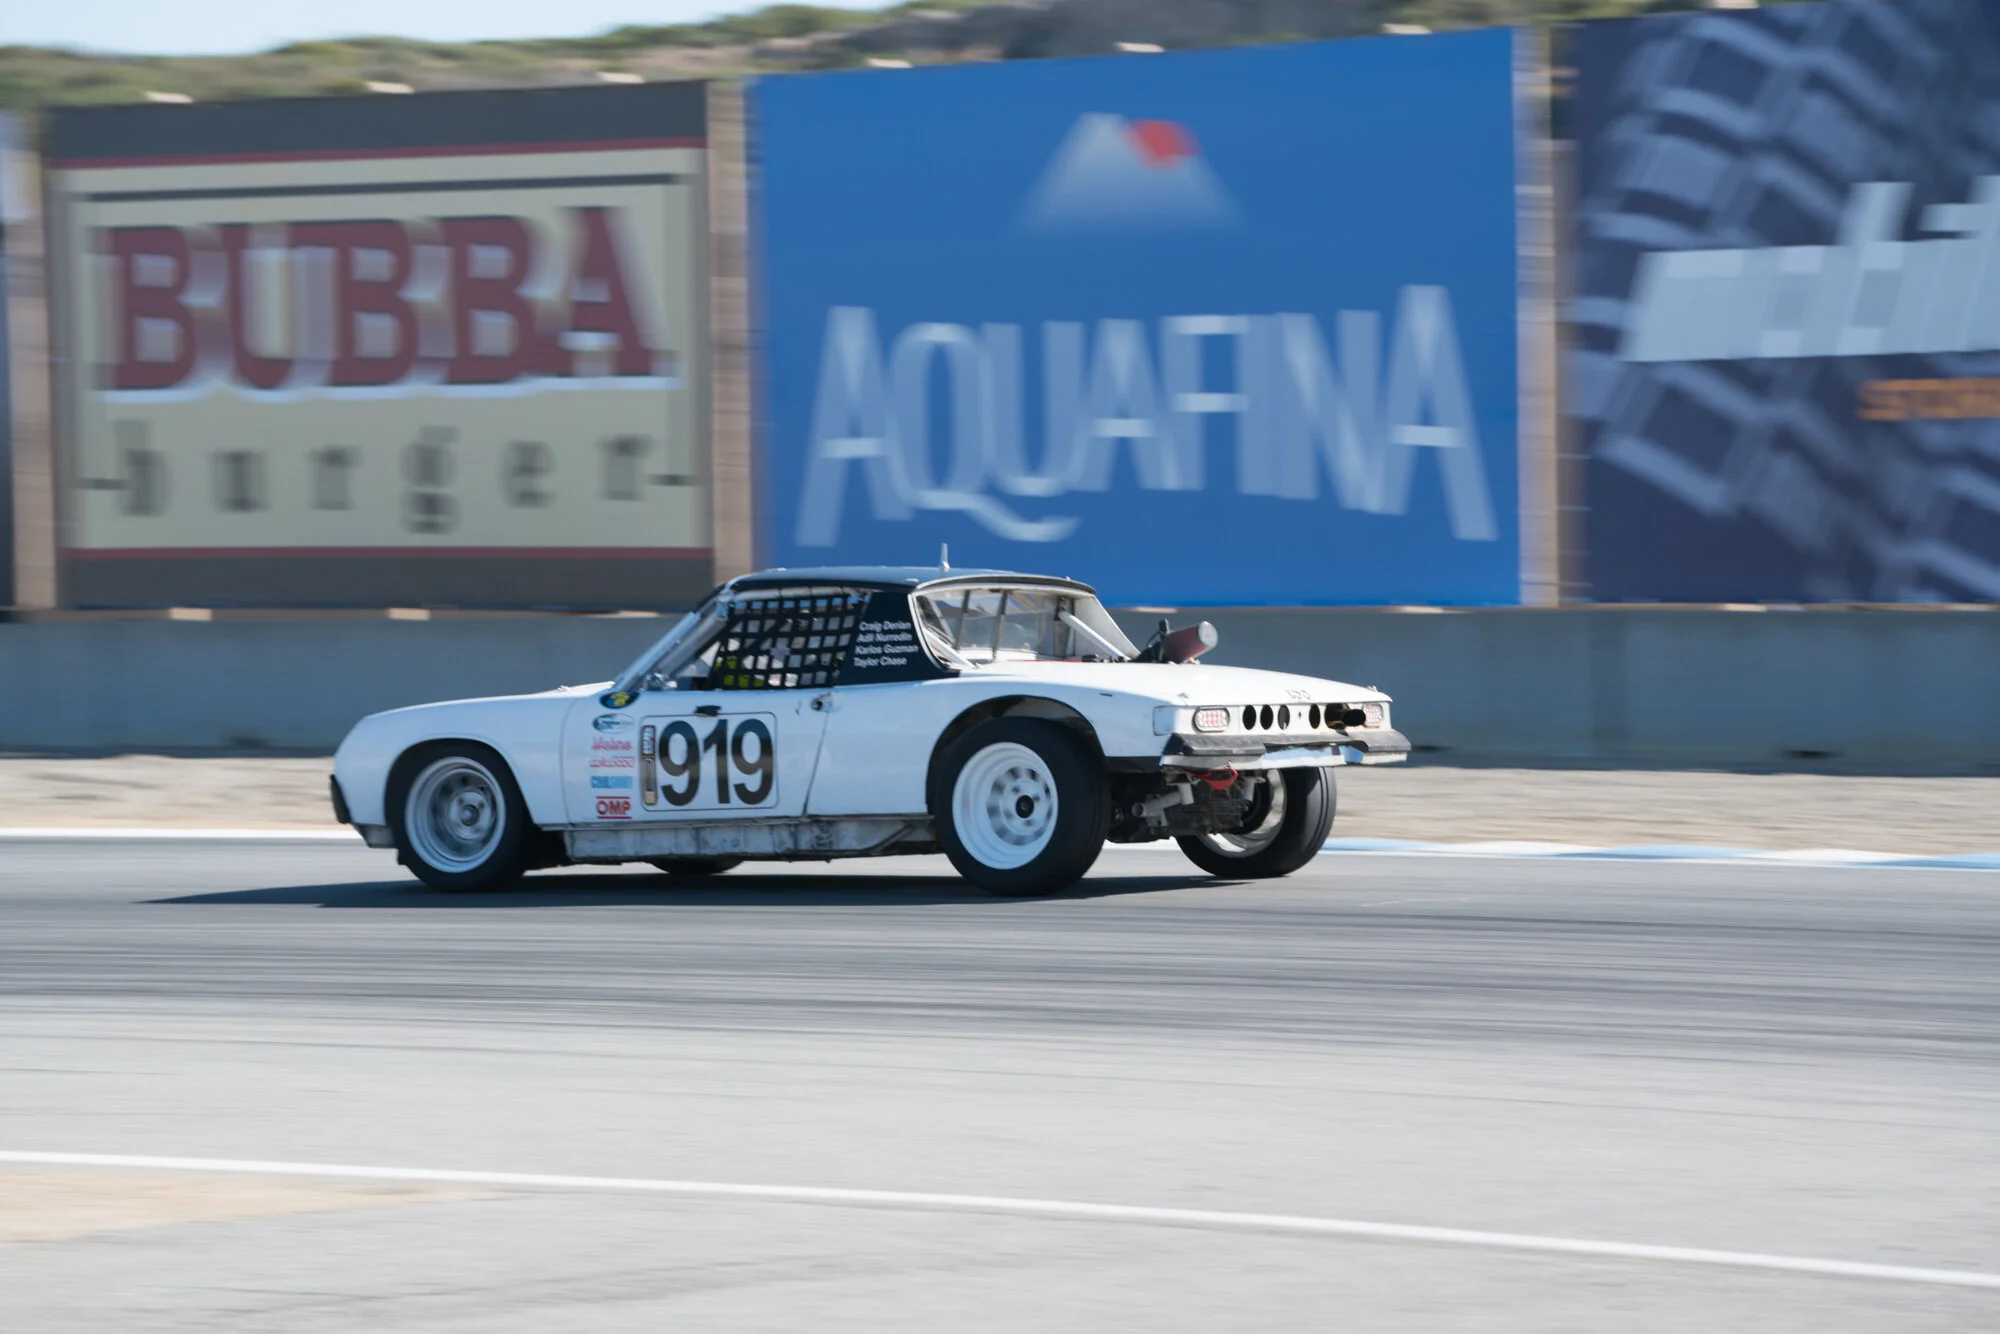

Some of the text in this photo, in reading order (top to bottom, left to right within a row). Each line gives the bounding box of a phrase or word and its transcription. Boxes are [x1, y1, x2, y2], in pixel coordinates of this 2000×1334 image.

[98, 206, 672, 391] BUBBA
[796, 285, 1497, 546] AQUAFINA
[113, 418, 653, 534] burger
[853, 656, 907, 668] Taylor Chase
[859, 621, 882, 632] Craig
[596, 799, 632, 815] OMP
[658, 718, 774, 807] 919
